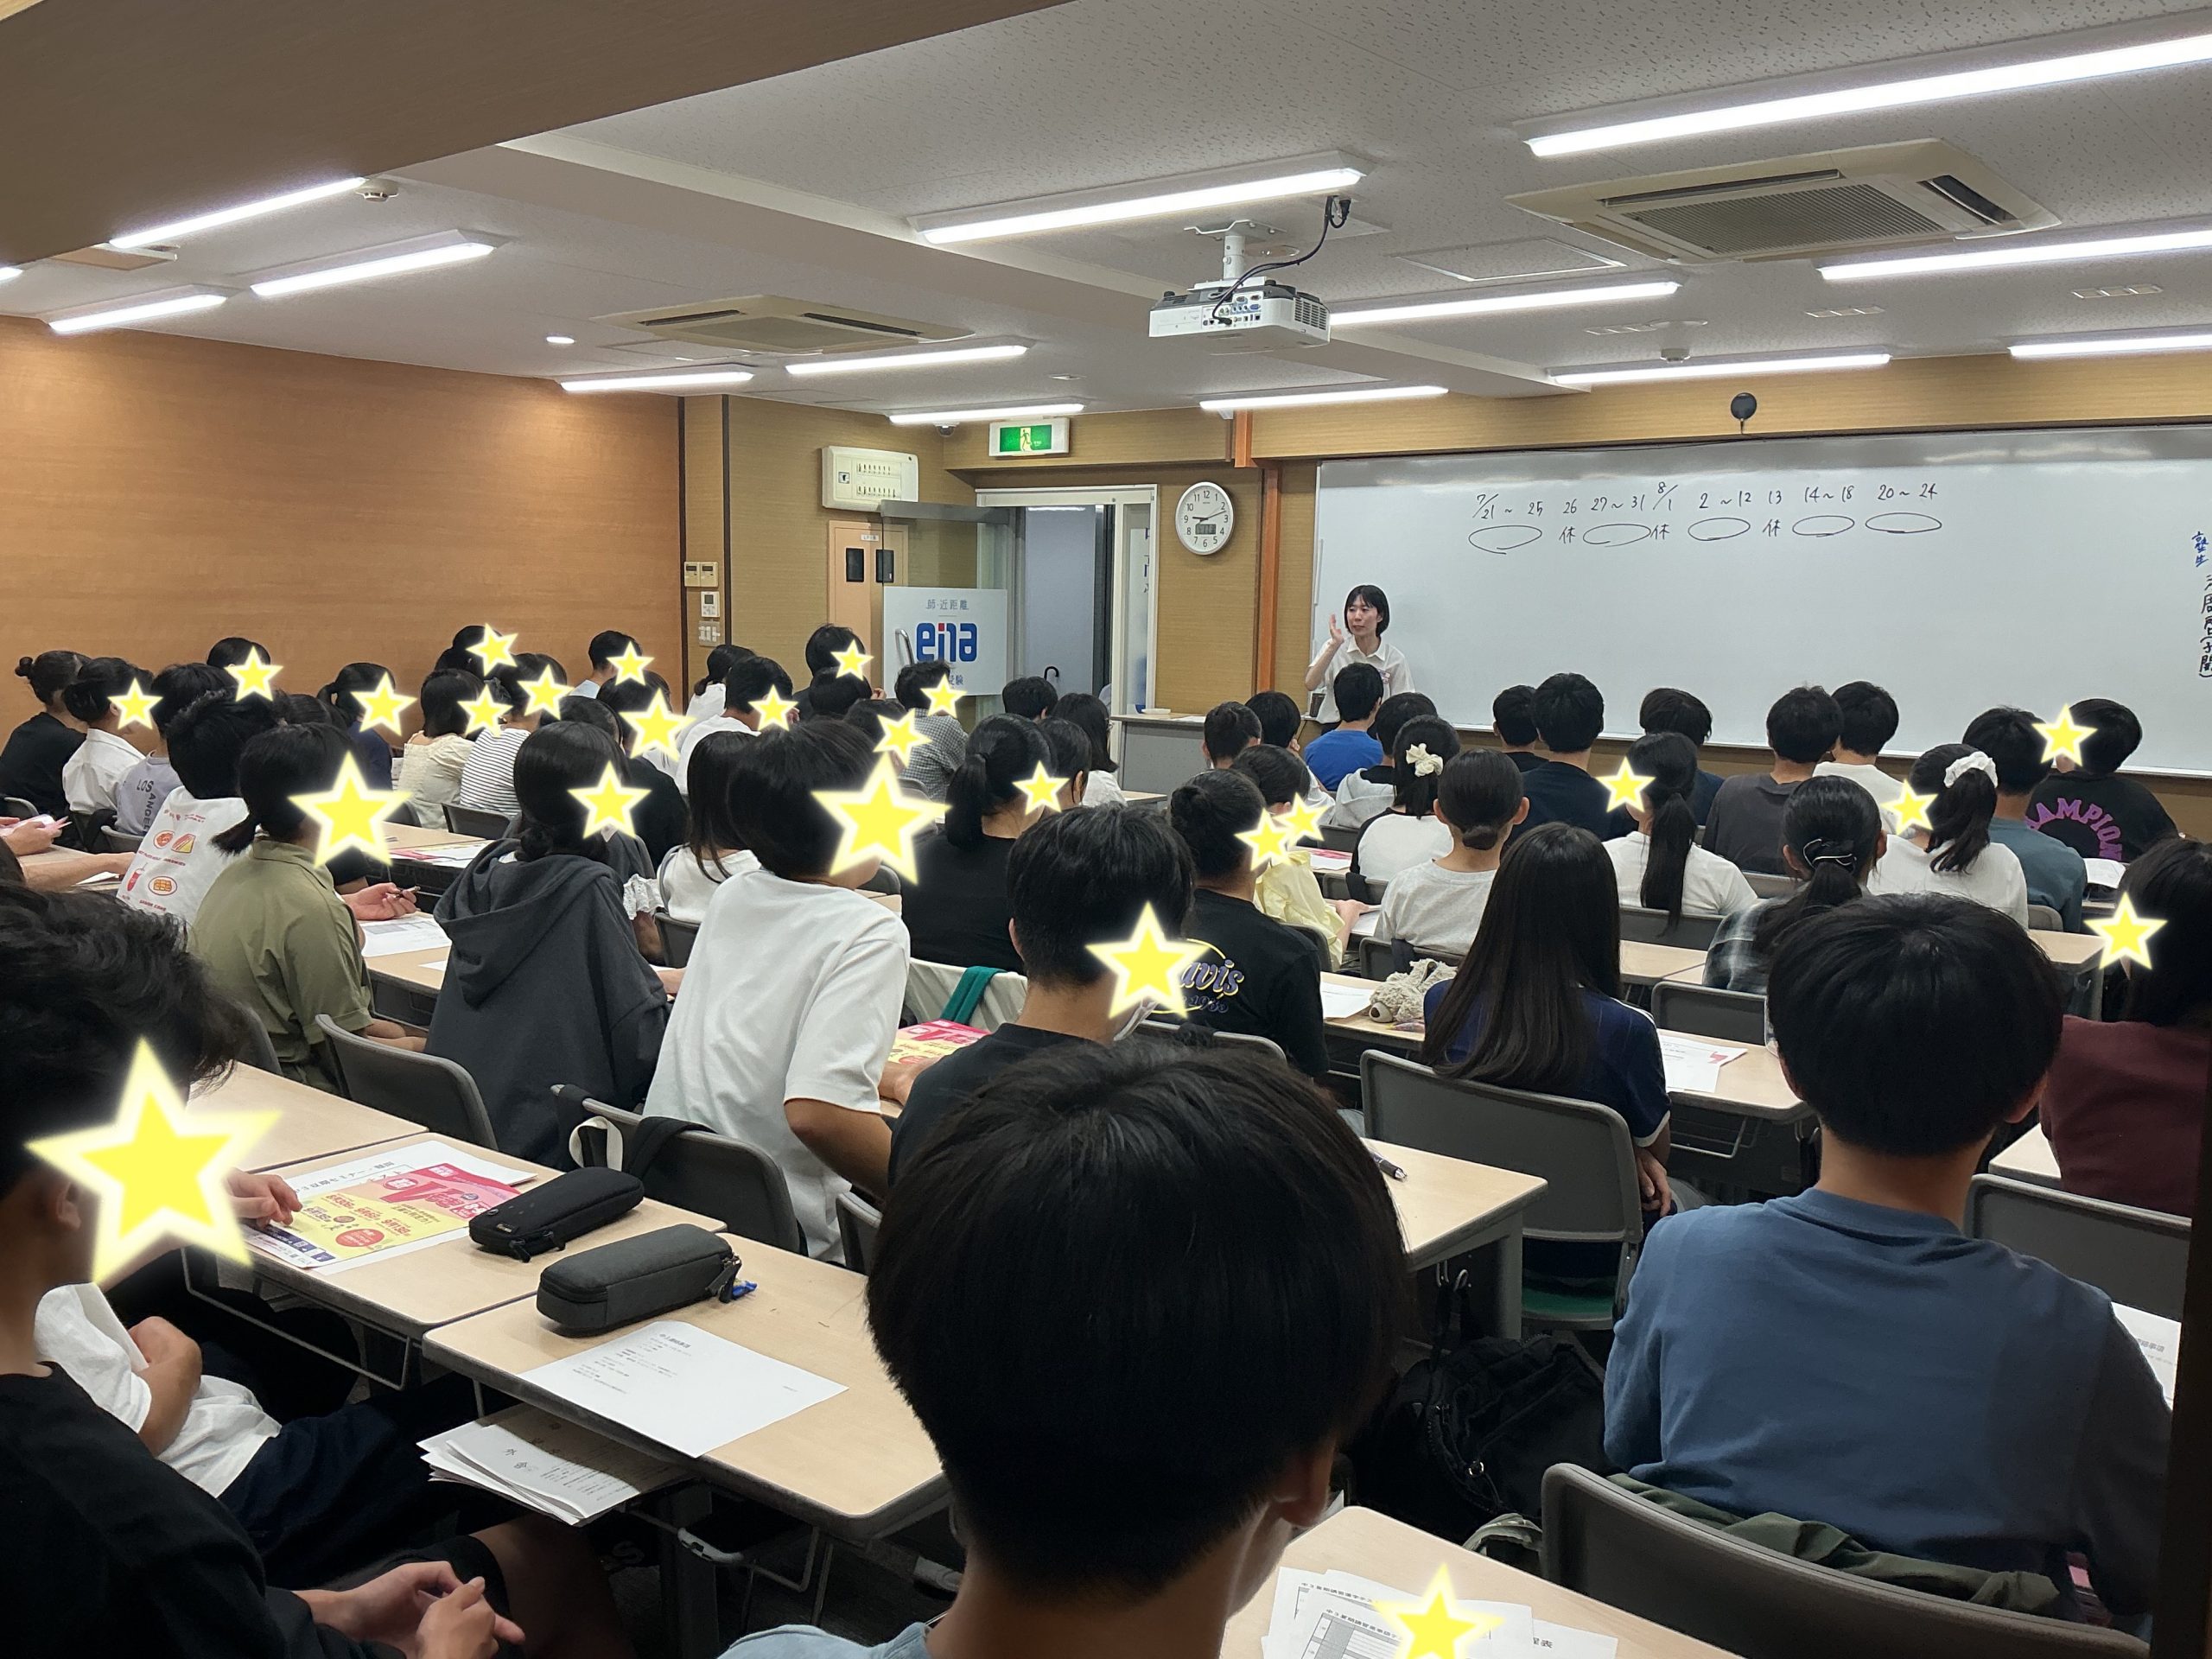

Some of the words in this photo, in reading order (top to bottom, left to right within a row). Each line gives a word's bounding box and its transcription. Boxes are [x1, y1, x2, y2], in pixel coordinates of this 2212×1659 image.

[1562, 499, 1578, 514] 26
[1769, 490, 1782, 505] 13
[916, 623, 977, 662] ena
[1180, 959, 1244, 995] avis
